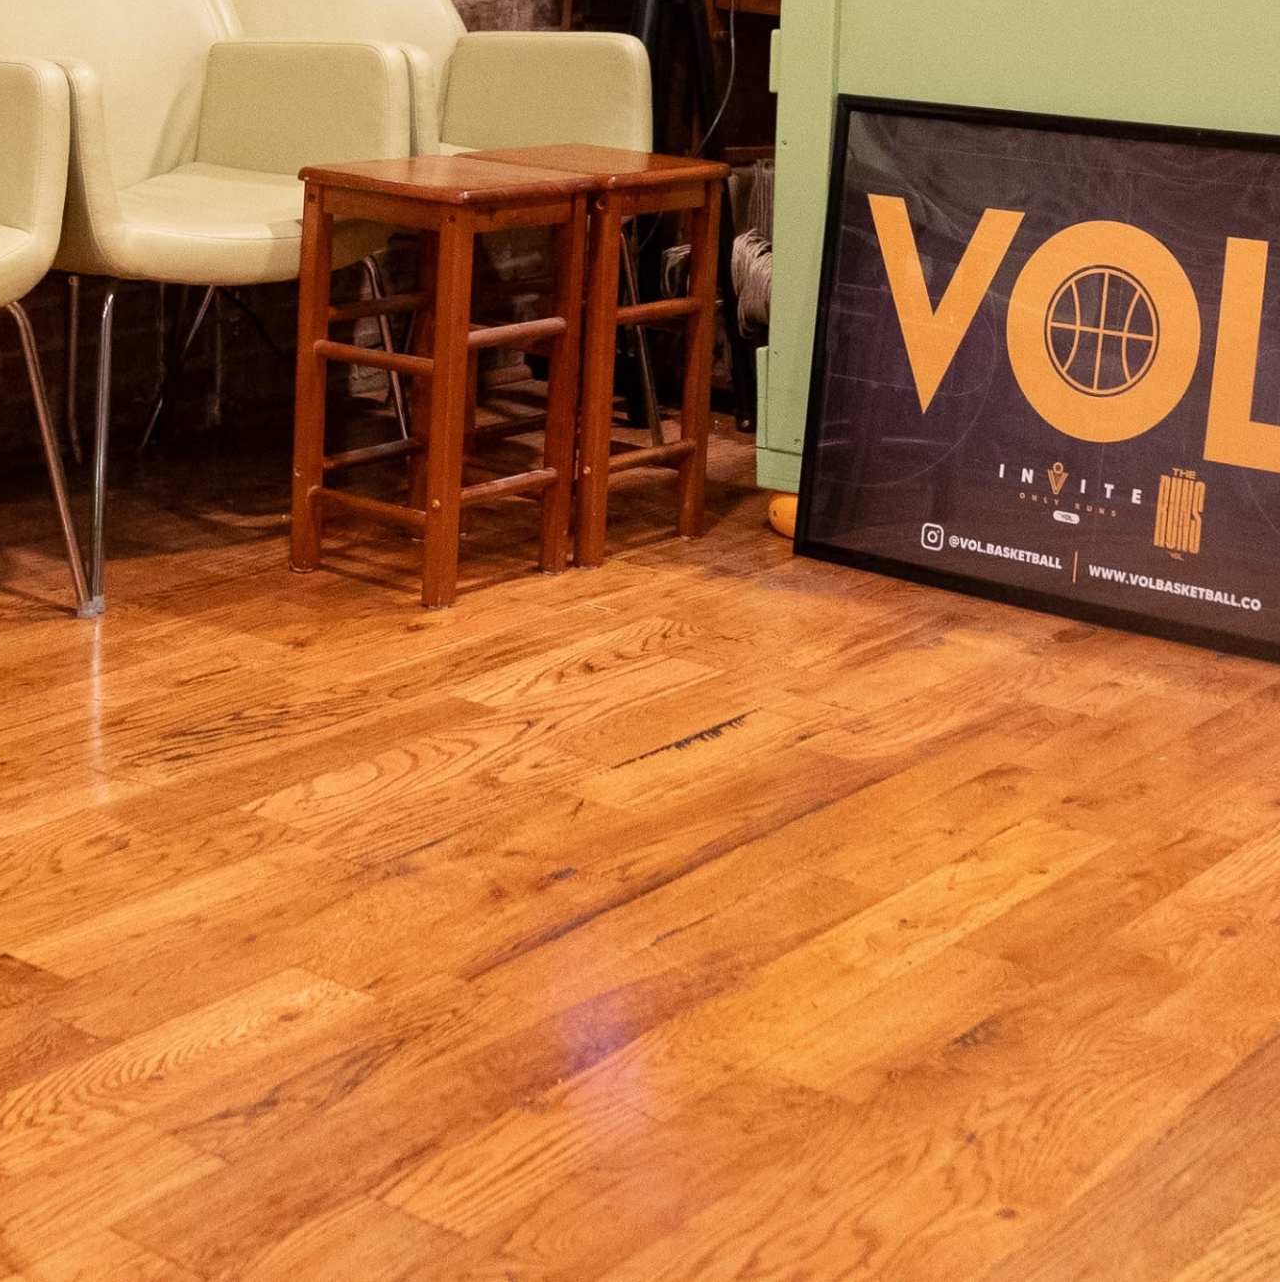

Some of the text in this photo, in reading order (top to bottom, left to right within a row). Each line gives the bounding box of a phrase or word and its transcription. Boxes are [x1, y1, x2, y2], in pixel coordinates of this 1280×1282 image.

[999, 462, 1142, 504] INVITE
[1172, 468, 1196, 479] THE
[1019, 492, 1060, 506] ONLY
[1074, 503, 1117, 517] RUNS
[948, 535, 1062, 569] @VOL.BASKETBALL
[1088, 564, 1262, 611] WWW.VOLBASKETBALL.CO
